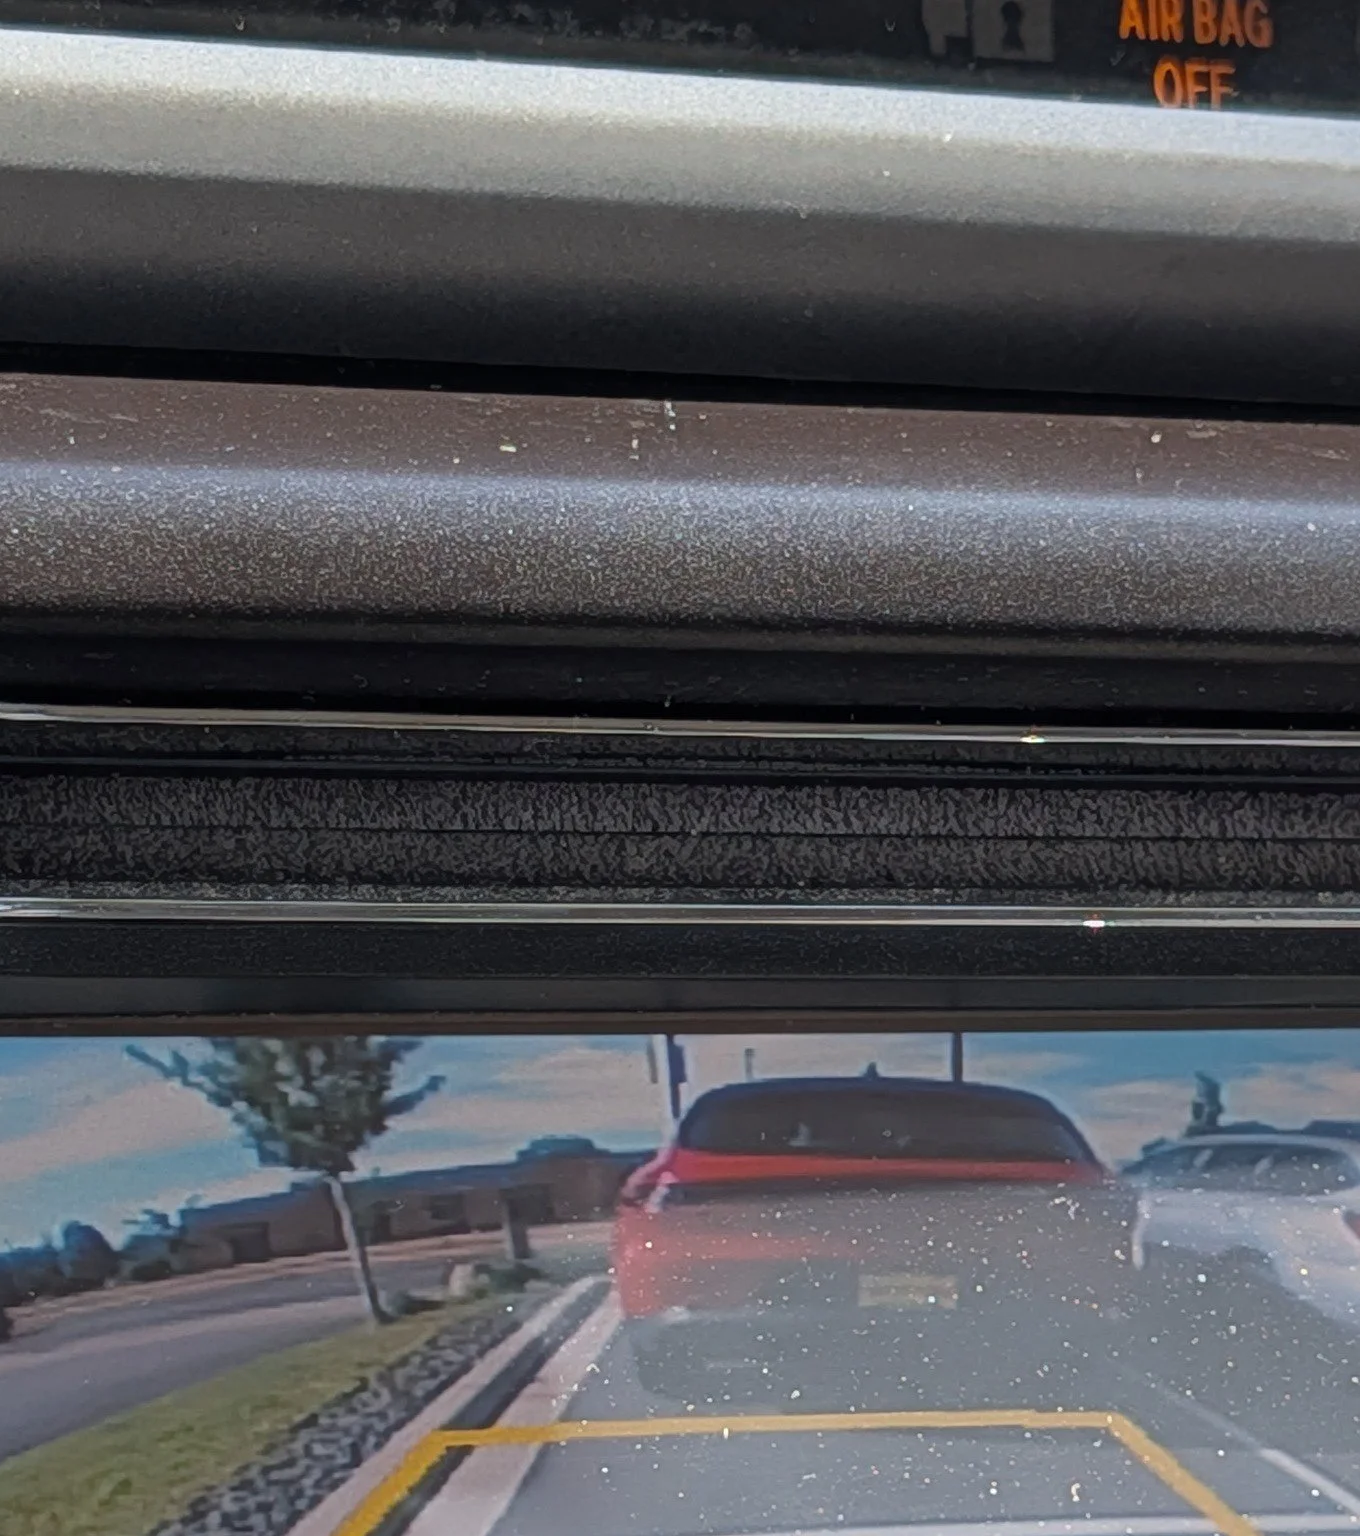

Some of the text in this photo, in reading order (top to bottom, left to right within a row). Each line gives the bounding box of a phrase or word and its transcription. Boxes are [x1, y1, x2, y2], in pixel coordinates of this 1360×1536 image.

[1119, 0, 1274, 48] AIR BAG
[1154, 55, 1237, 109] OFF
